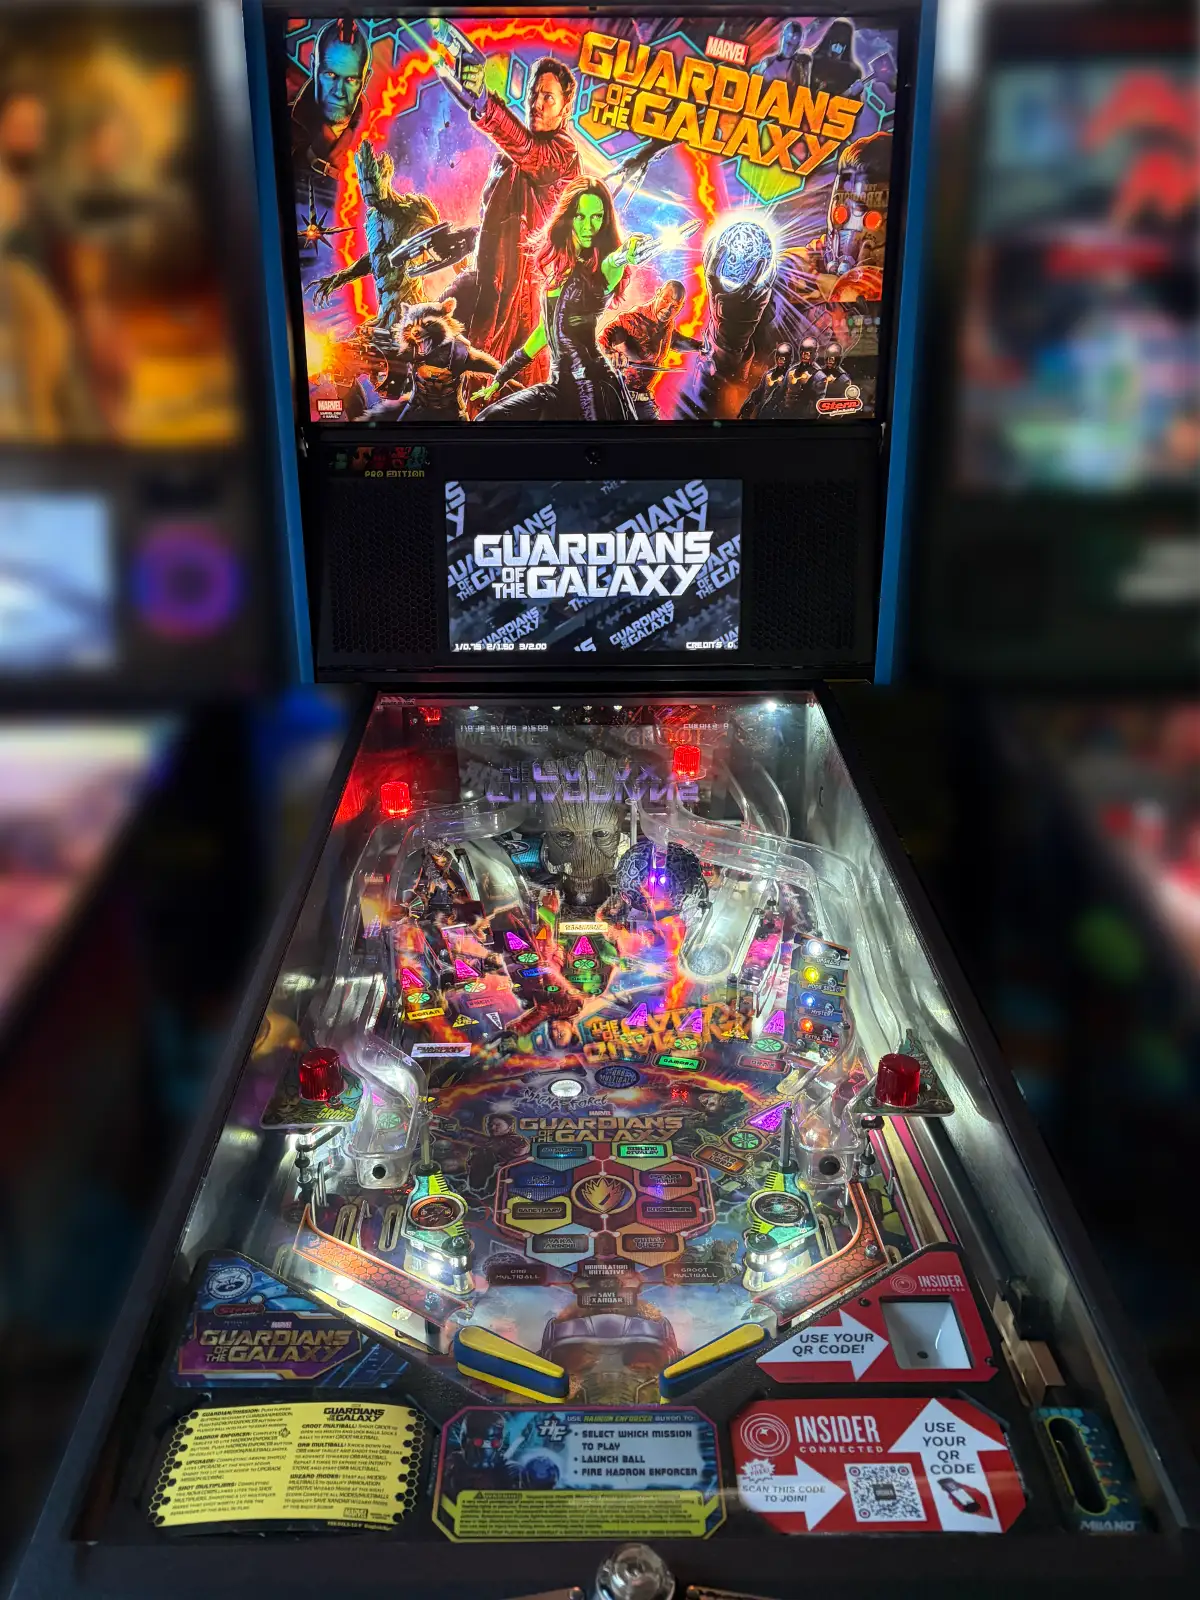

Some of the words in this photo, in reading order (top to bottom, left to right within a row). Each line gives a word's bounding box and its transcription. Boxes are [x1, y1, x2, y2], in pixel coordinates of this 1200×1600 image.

[705, 36, 749, 64] MARVEL
[578, 31, 864, 140] GUARDIANS
[606, 84, 636, 106] OF
[592, 101, 630, 130] THE
[631, 91, 841, 175] GALAXY
[318, 400, 343, 411] MARVEL
[821, 402, 857, 410] Stern
[474, 531, 713, 566] GUARDIANS
[492, 583, 526, 598] THE
[527, 564, 704, 598] GALAXY
[502, 568, 527, 582] OF
[457, 587, 476, 601] THE
[696, 586, 715, 599] THE
[610, 600, 675, 645] GUARDIANS
[629, 610, 674, 645] GALAXY
[520, 1117, 683, 1129] GUARDIANS
[555, 1130, 679, 1142] GALAXY
[708, 1156, 732, 1168] LORD
[713, 1152, 736, 1163] STAR
[918, 1275, 963, 1287] INSIDER
[200, 1330, 353, 1346] GUARDIANS
[800, 1334, 828, 1343] USE
[833, 1333, 874, 1342] YOUR
[206, 1354, 226, 1362] THE
[228, 1346, 342, 1362] GALAXY
[214, 1346, 230, 1354] OF
[792, 1346, 812, 1356] QR
[819, 1345, 864, 1354] CODE!
[323, 1407, 385, 1416] GUARDIANS
[795, 1416, 880, 1444] INSIDER
[925, 1422, 955, 1433] USE
[582, 1430, 615, 1438] SELECT
[618, 1430, 647, 1438] WHICH
[652, 1430, 692, 1438] MISSION
[582, 1442, 594, 1450] TO
[597, 1442, 620, 1450] PLAY
[923, 1436, 966, 1446] YOUR
[800, 1446, 883, 1454] CONNECTED
[937, 1451, 960, 1461] QR
[582, 1455, 619, 1463] LAUNCH
[622, 1455, 645, 1463] BALL
[582, 1467, 602, 1476] FIRE
[606, 1468, 645, 1476] HADRON
[649, 1467, 697, 1476] ENFORCER
[930, 1464, 975, 1474] CODE
[1080, 1521, 1135, 1531] MILANO
